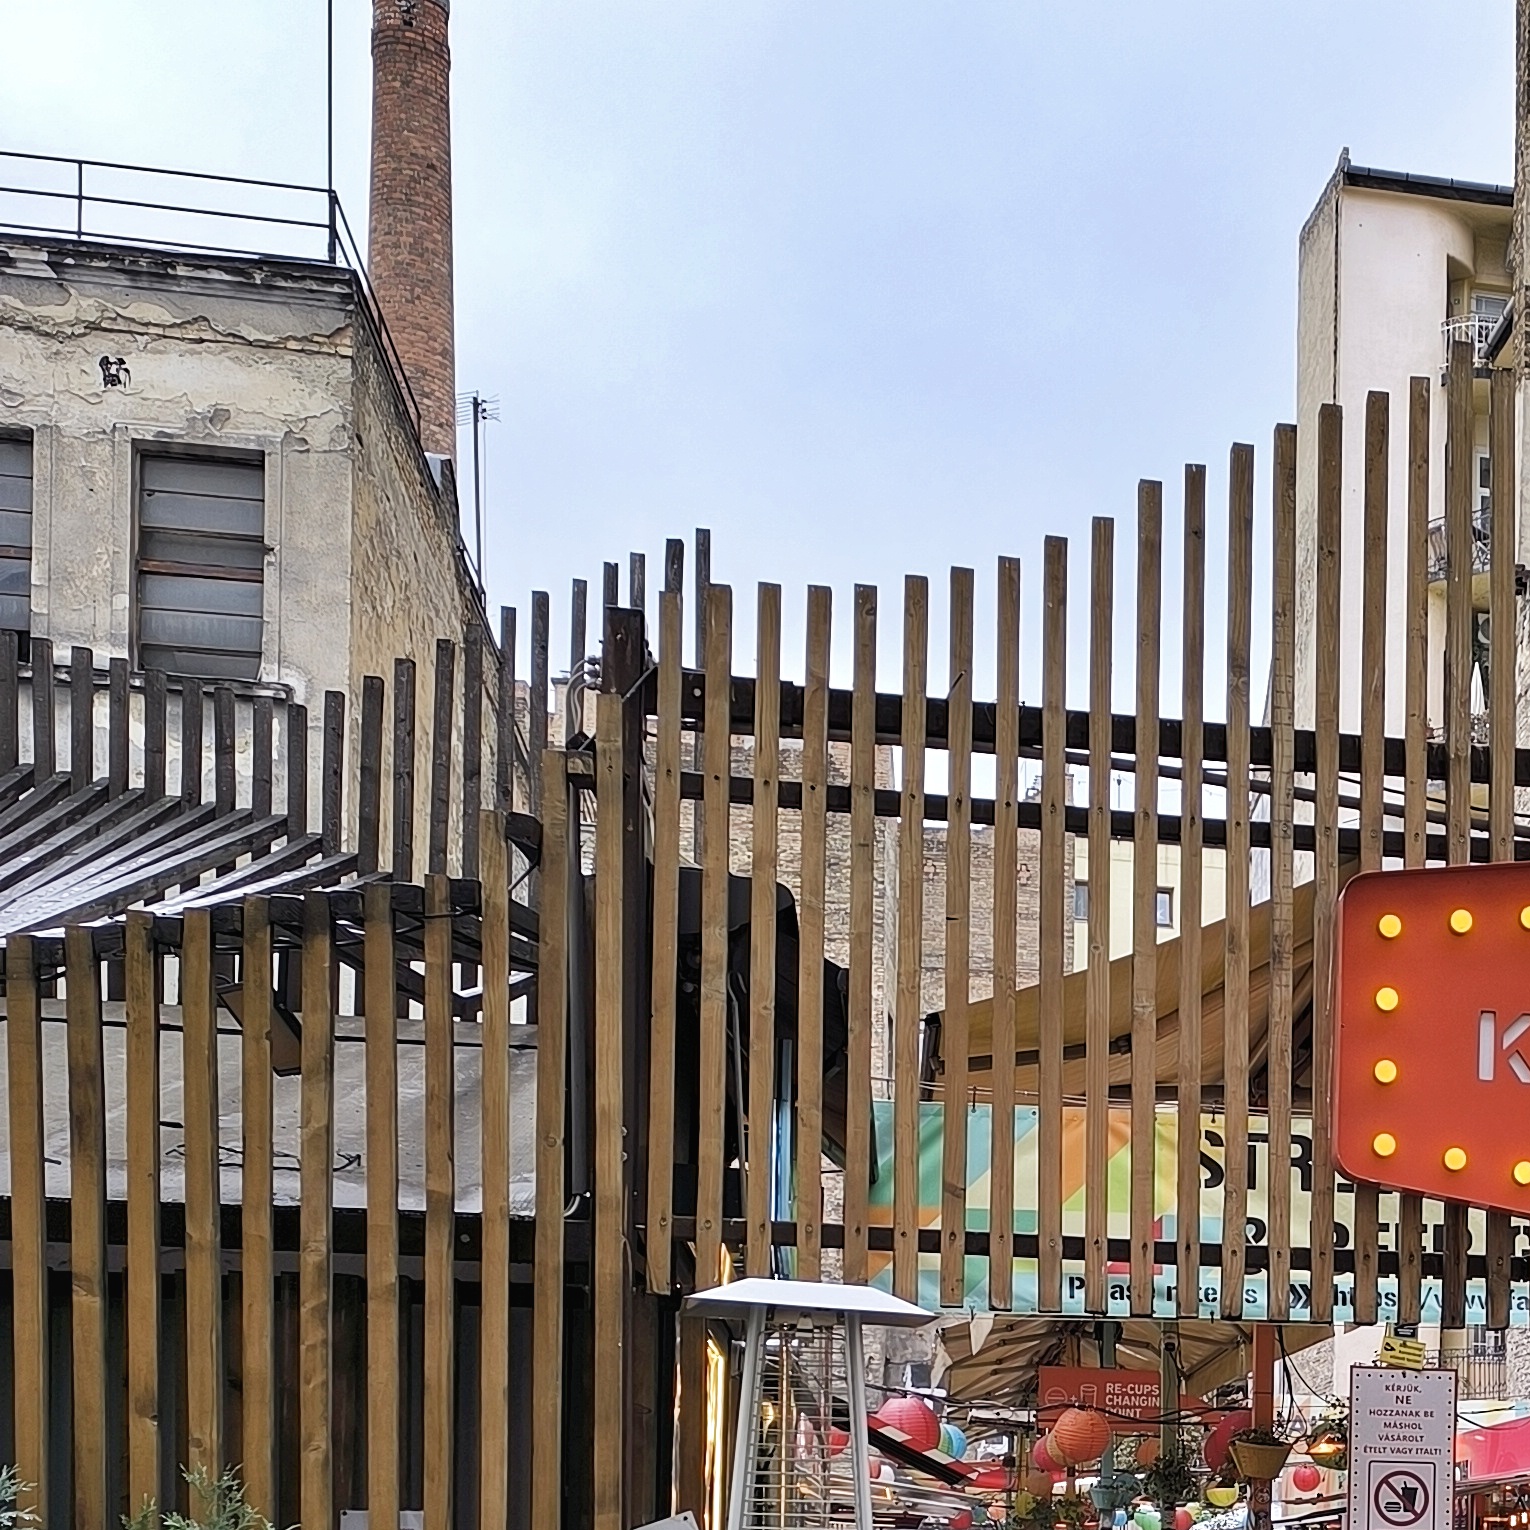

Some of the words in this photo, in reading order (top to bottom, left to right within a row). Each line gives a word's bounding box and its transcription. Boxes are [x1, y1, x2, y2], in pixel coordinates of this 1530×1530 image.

[1105, 1382, 1160, 1395] RE-CUPS
[1384, 1383, 1422, 1394] KÉRJÜK,
[1105, 1395, 1161, 1407] CHANGIN
[1395, 1394, 1412, 1405] NE
[1368, 1408, 1421, 1418] HOZZANAK
[1423, 1409, 1435, 1418] BE
[1383, 1419, 1423, 1430] MÁSHOL
[1377, 1432, 1425, 1443] VÁSÁROLT
[1363, 1444, 1388, 1455] ÉTELT
[1389, 1446, 1414, 1455] VAGY
[1415, 1446, 1442, 1456] ITALT!
